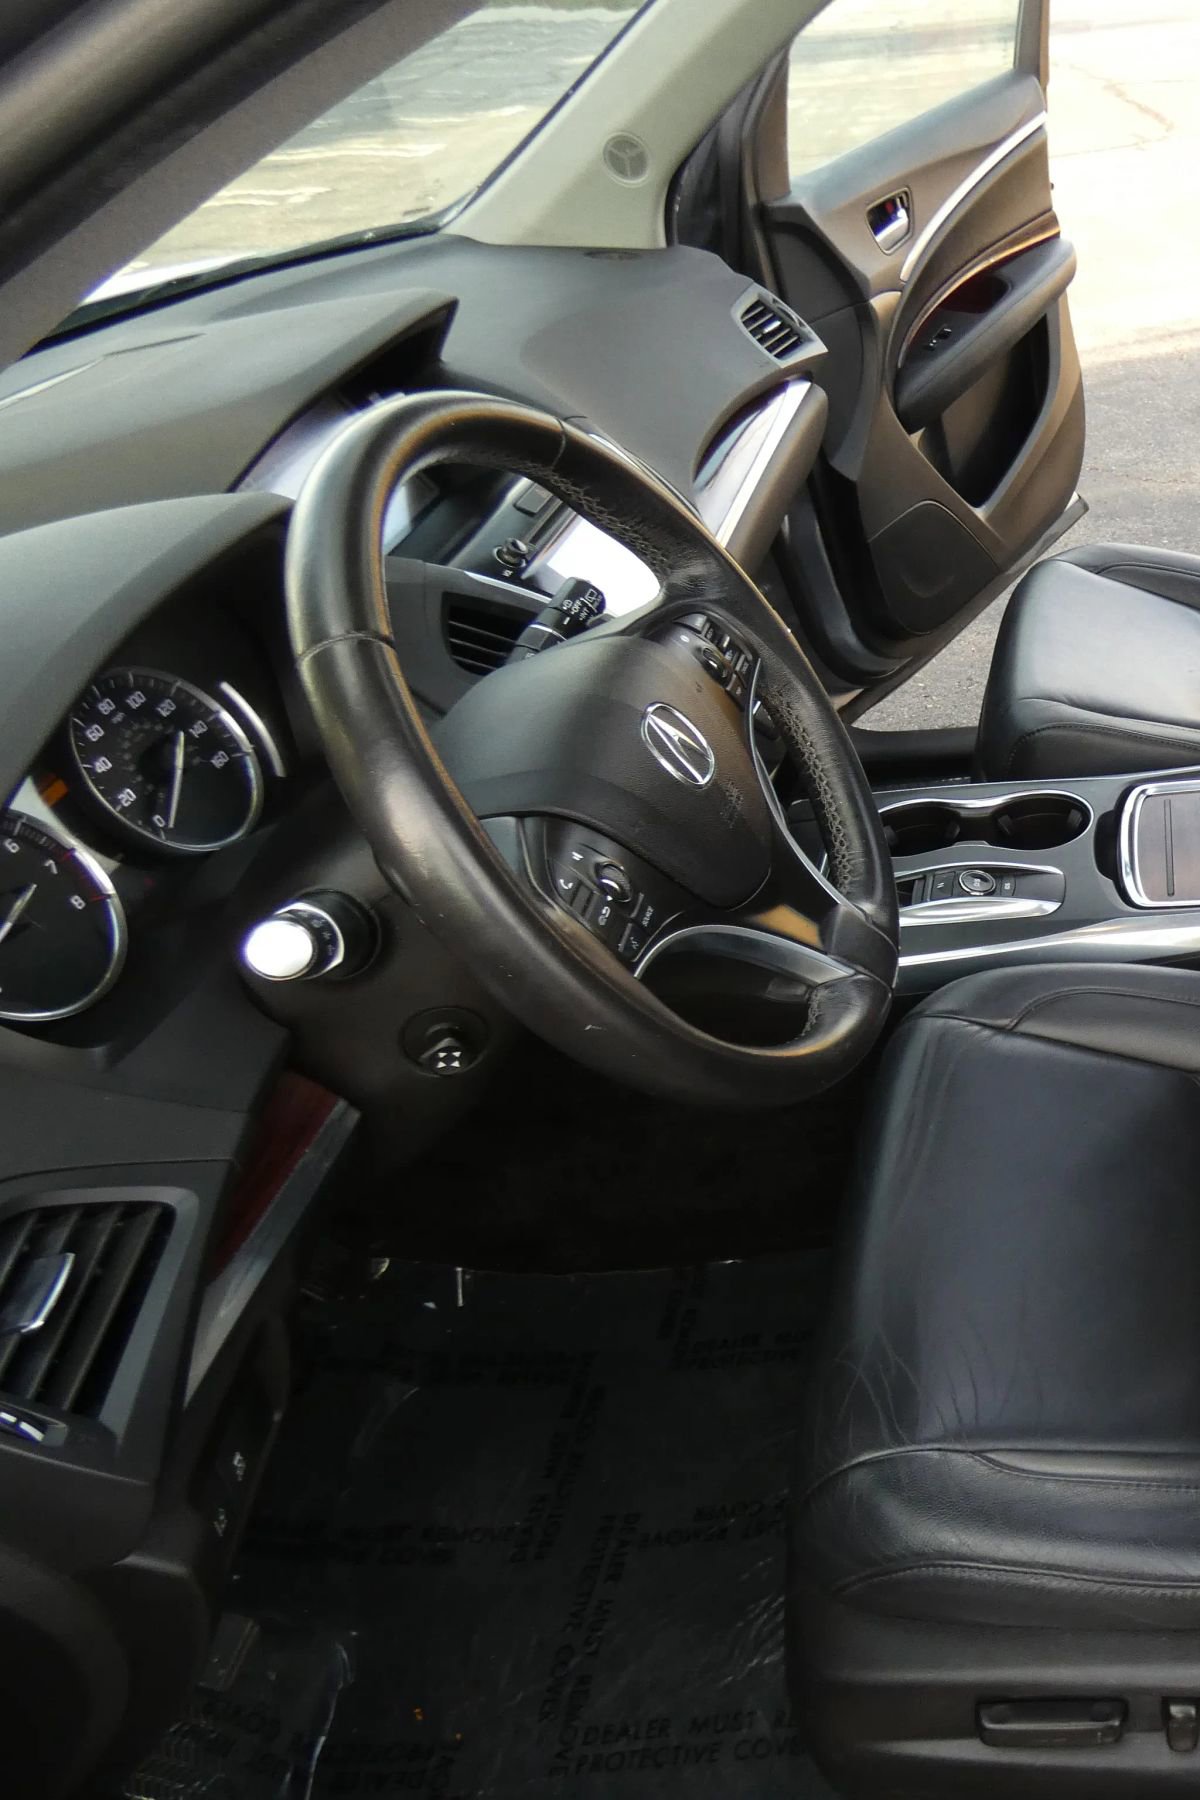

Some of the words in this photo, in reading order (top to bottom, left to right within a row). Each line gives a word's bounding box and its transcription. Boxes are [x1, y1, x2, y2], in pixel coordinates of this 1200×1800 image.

[98, 698, 116, 715] 80
[126, 691, 146, 709] 100
[156, 699, 176, 717] 120
[85, 724, 104, 742] 60
[189, 720, 208, 738] 140
[94, 756, 112, 773] 40
[211, 751, 229, 768] 160
[118, 788, 137, 807] 20
[152, 815, 166, 827] 0
[4, 838, 20, 853] 6
[44, 859, 58, 874] 7
[70, 895, 86, 910] 8
[581, 1716, 672, 1746] DEALER
[688, 1708, 758, 1735] MUST
[574, 1740, 723, 1776] PROTECTIVE
[734, 1735, 803, 1762] COVE
